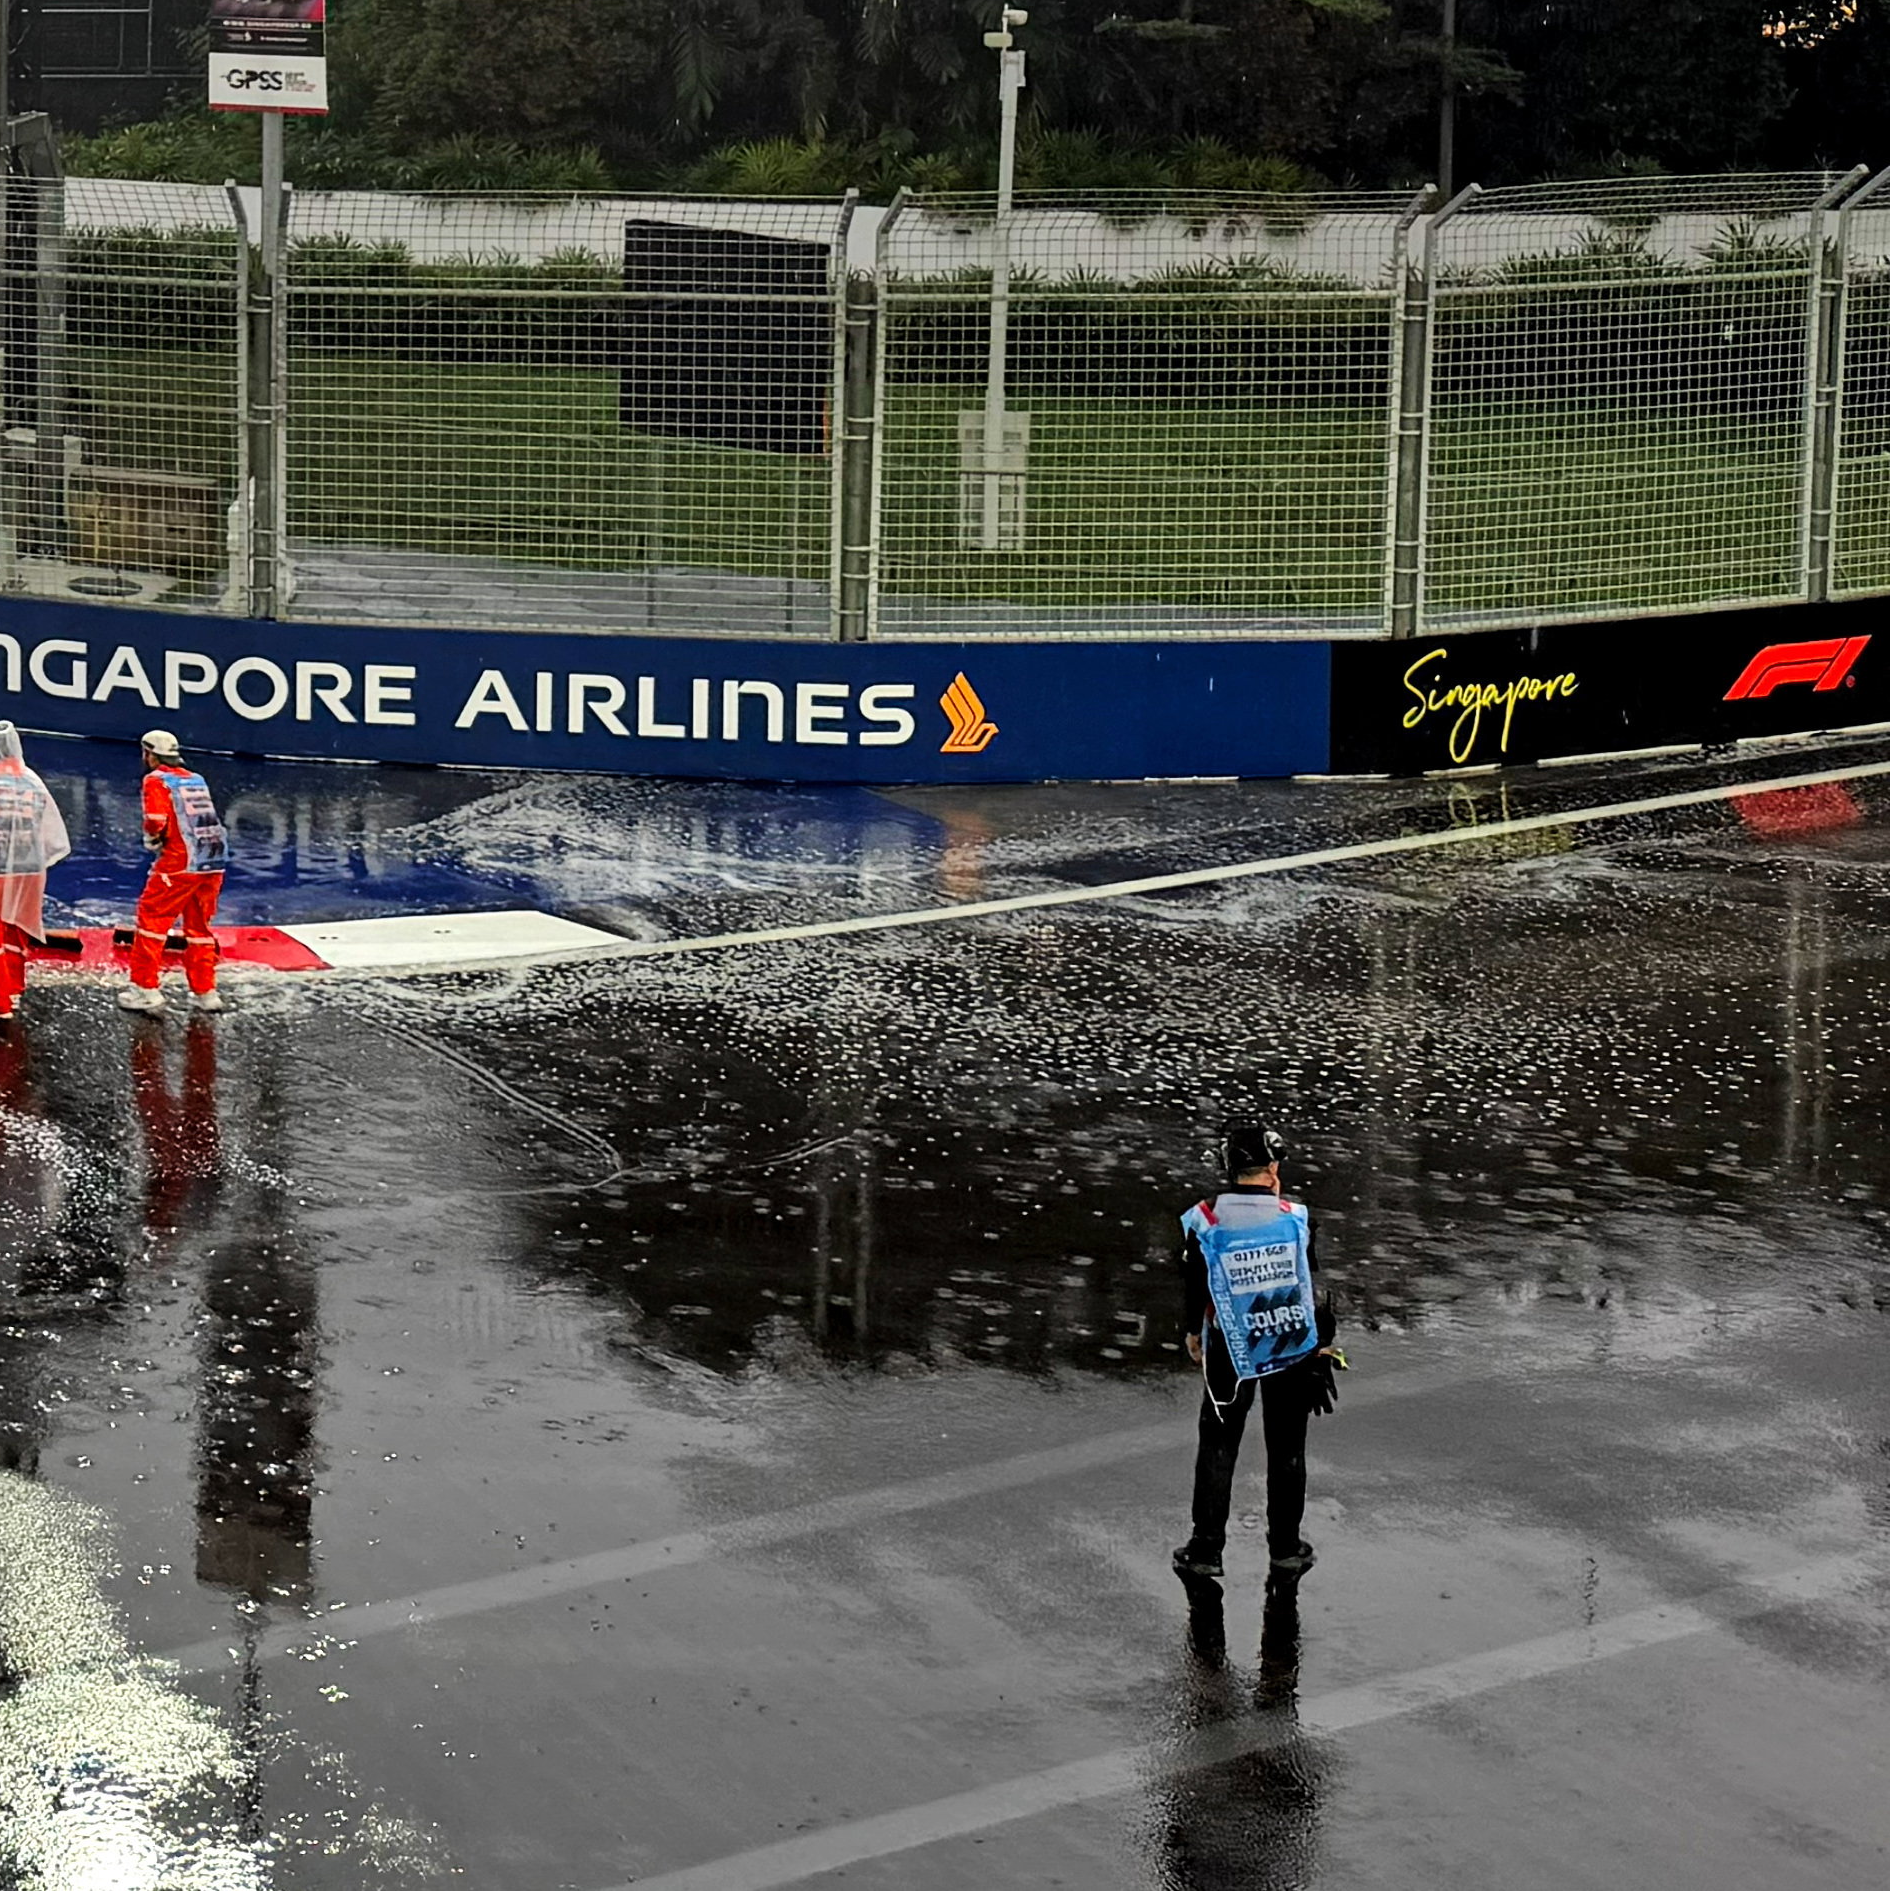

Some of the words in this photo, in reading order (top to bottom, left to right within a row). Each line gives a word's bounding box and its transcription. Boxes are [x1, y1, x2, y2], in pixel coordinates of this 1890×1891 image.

[225, 68, 283, 91] GPSS
[1722, 634, 1873, 701] F1
[455, 669, 918, 749] AIRLINES
[1402, 648, 1580, 763] Singapore
